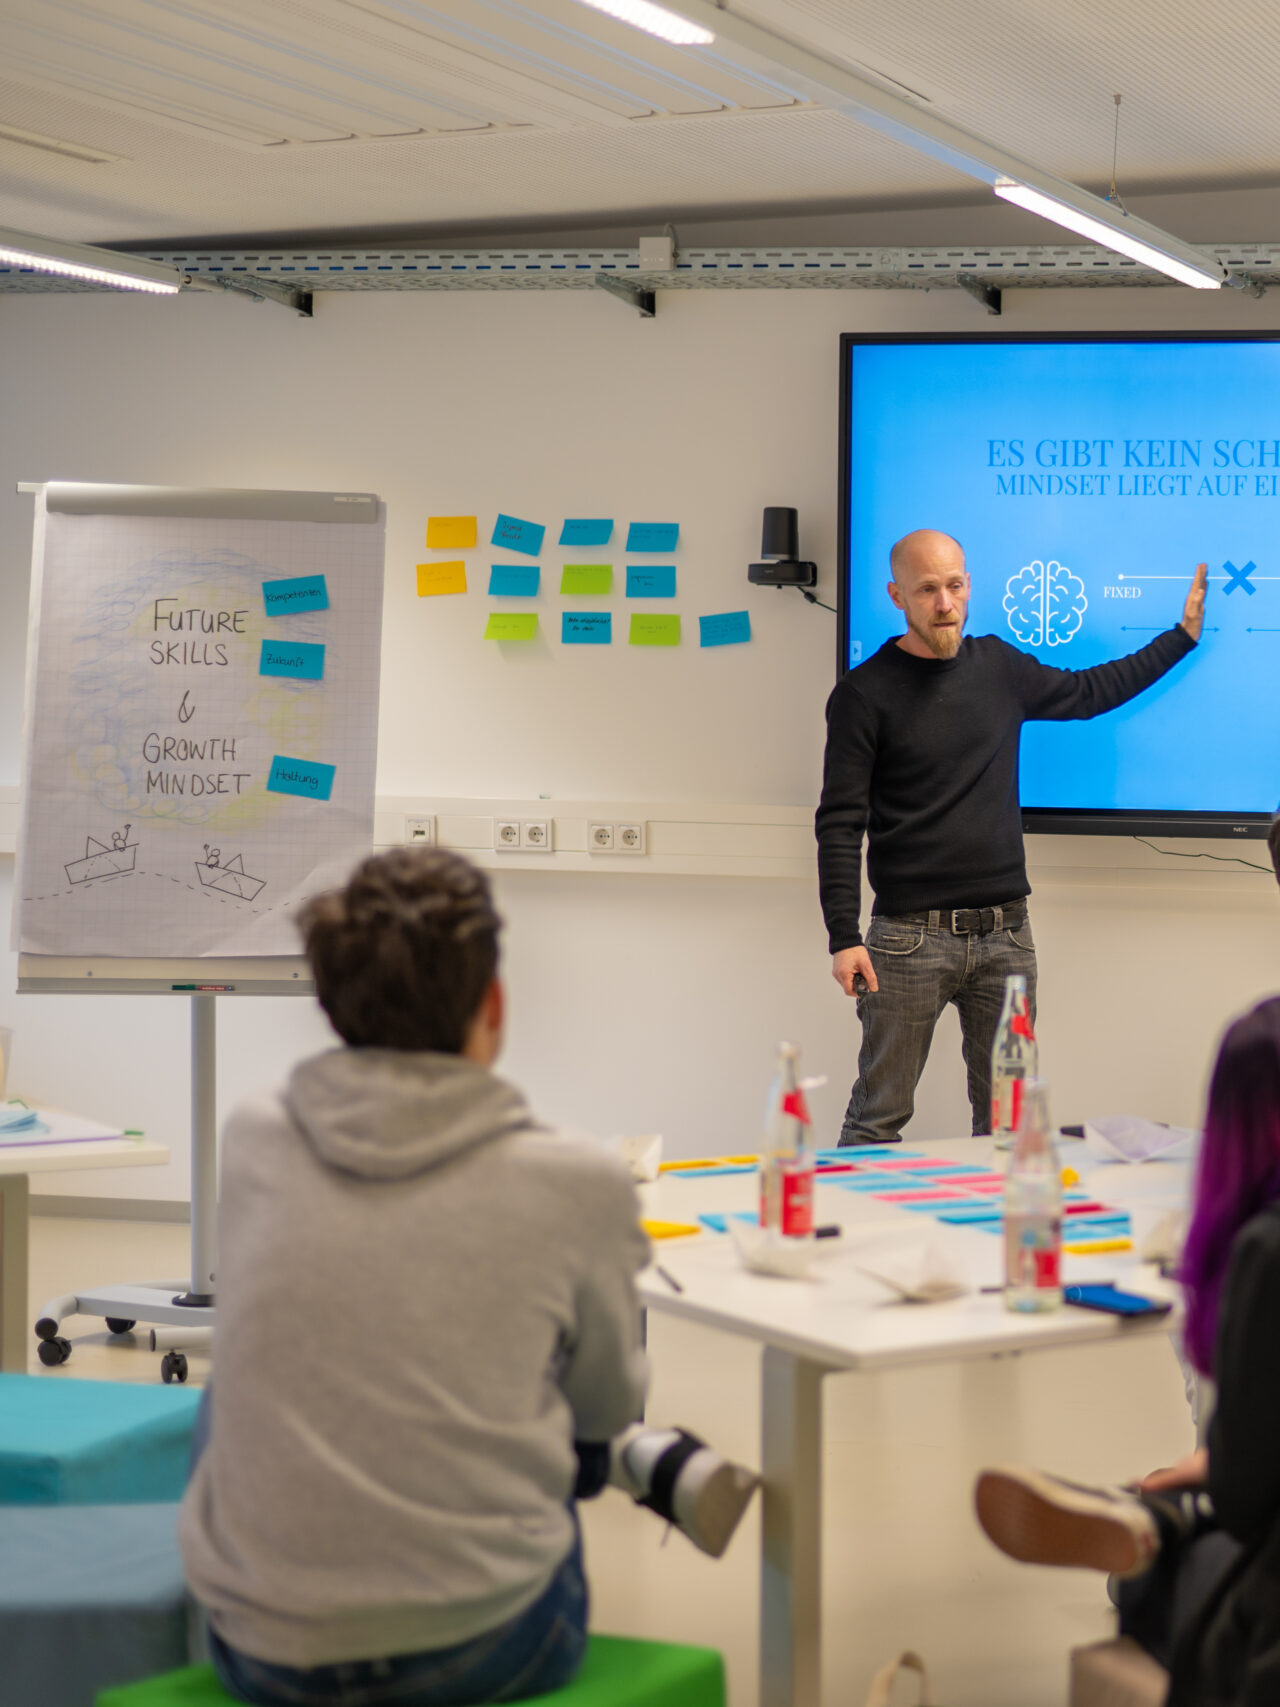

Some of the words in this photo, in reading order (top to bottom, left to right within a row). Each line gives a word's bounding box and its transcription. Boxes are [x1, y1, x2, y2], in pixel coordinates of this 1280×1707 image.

[987, 439, 1025, 468] ES
[1035, 439, 1114, 468] GIBT
[1123, 439, 1203, 468] KEIN
[996, 474, 1111, 496] MINDSET
[1118, 474, 1192, 496] LIEGT
[1197, 475, 1247, 497] AUF
[1103, 586, 1142, 599] FIXED
[149, 640, 229, 666] SKILLS
[178, 690, 195, 723] &
[142, 732, 237, 764] GROWTH
[146, 770, 252, 797] MINDSET
[275, 767, 319, 790] Haltung
